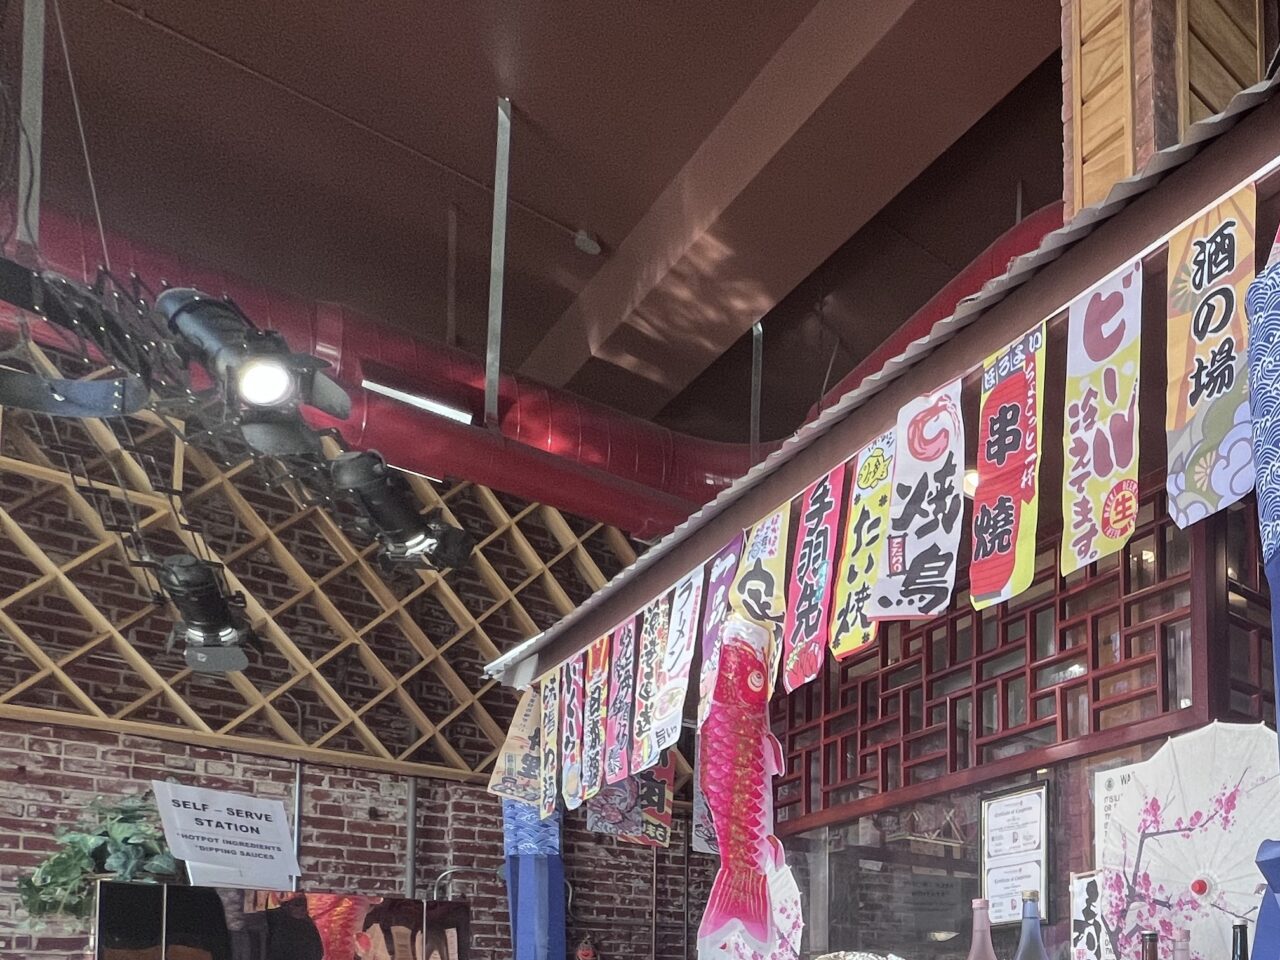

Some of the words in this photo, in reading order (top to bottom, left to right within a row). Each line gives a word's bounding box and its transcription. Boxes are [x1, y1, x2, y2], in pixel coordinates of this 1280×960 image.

[984, 332, 1042, 389] ほろよい
[1189, 220, 1237, 407] 酒の場
[1082, 258, 1140, 478] ビール
[975, 403, 1022, 561] 串焼
[1112, 493, 1134, 524] 生
[790, 478, 834, 642] 手羽先
[838, 505, 882, 633] たい焼
[878, 450, 964, 615] 焼鳥
[667, 576, 694, 673] ラーメン
[171, 799, 209, 812] SELF
[226, 807, 273, 822] SERVE
[194, 817, 261, 835] STATION
[222, 839, 282, 852] INGREDIENTS
[239, 850, 275, 860] SAUCES
